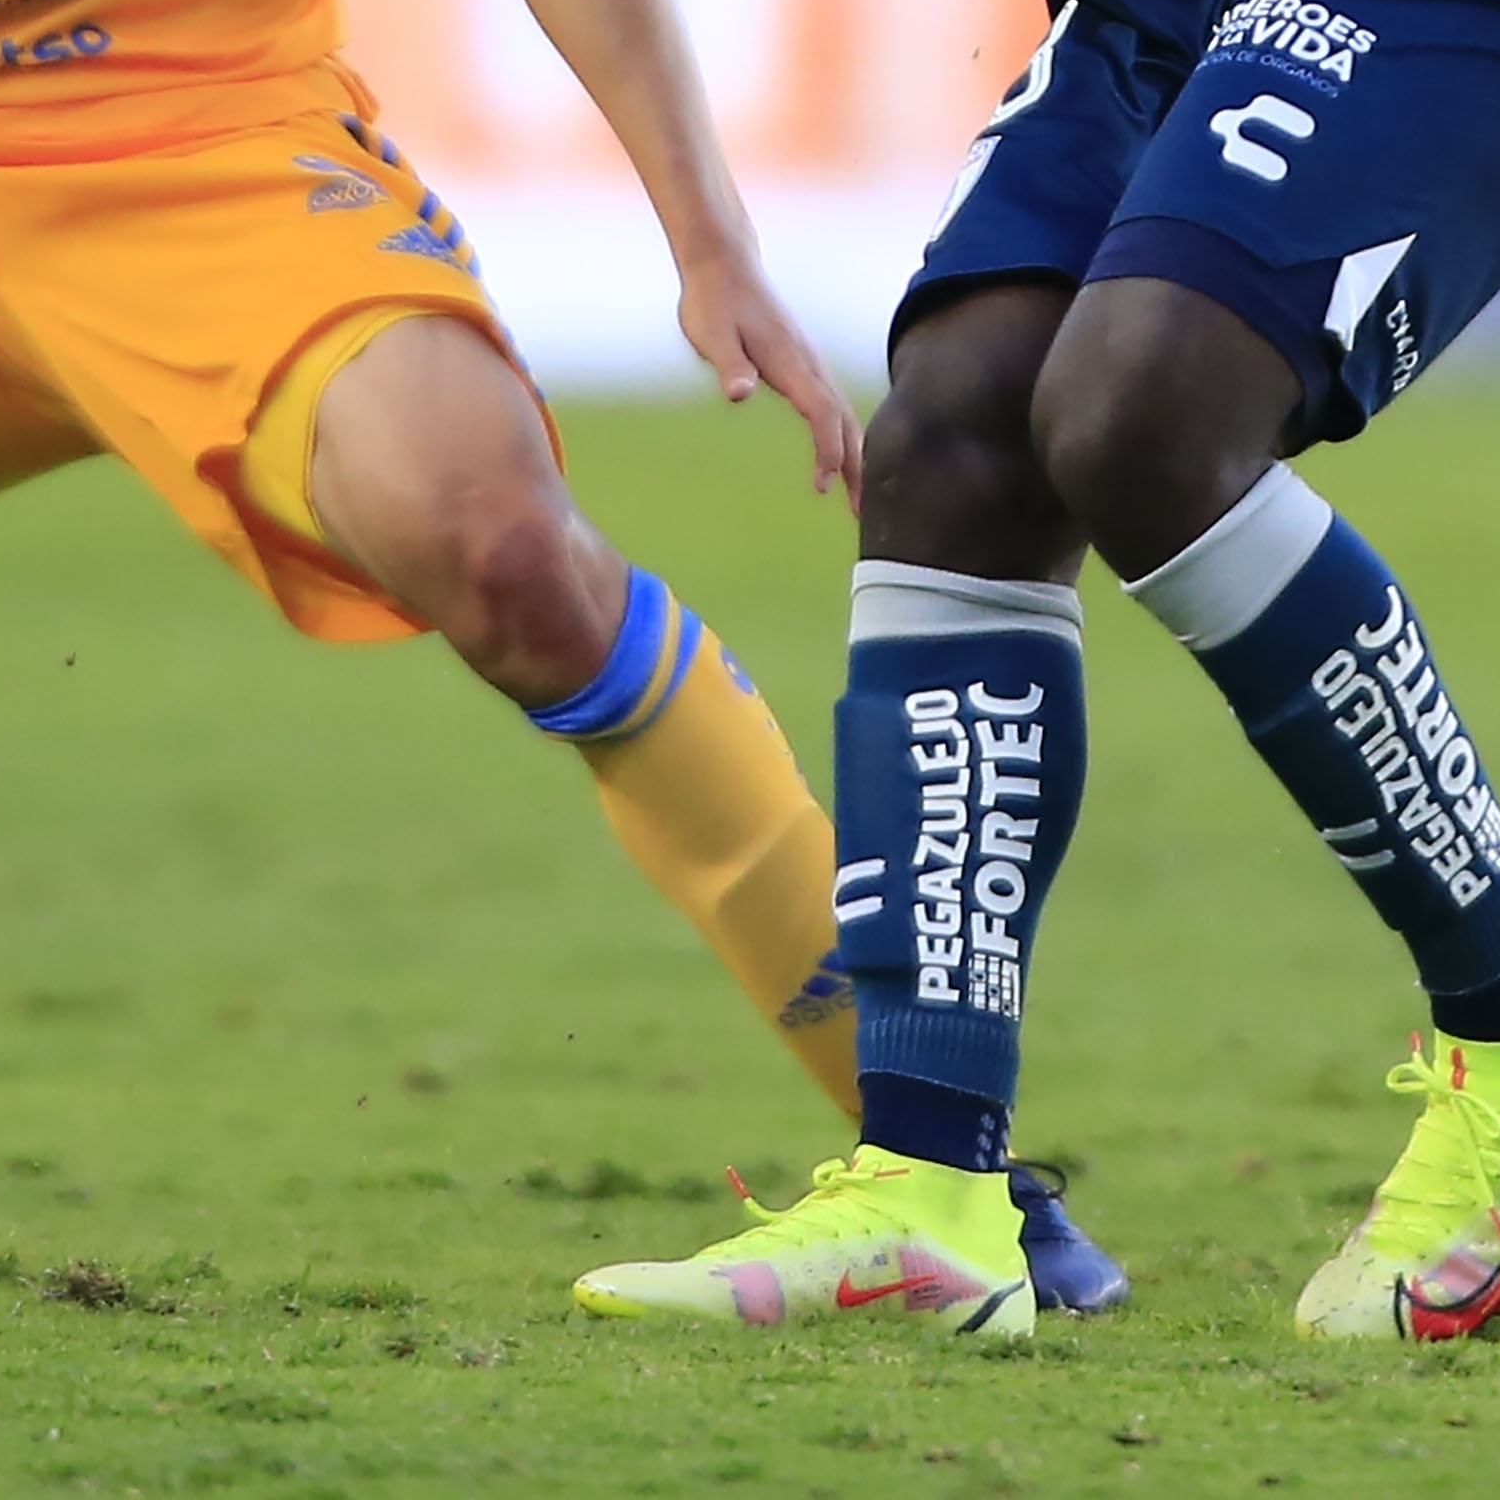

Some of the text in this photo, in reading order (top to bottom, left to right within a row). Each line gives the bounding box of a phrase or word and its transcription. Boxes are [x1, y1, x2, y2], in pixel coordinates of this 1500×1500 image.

[1251, 16, 1355, 83] VIDA
[966, 680, 1046, 959] FORTEC
[1310, 648, 1493, 908] PEGAZULEJO
[1354, 584, 1491, 833] FORTEC
[904, 687, 971, 1003] PEGAZULEJO
